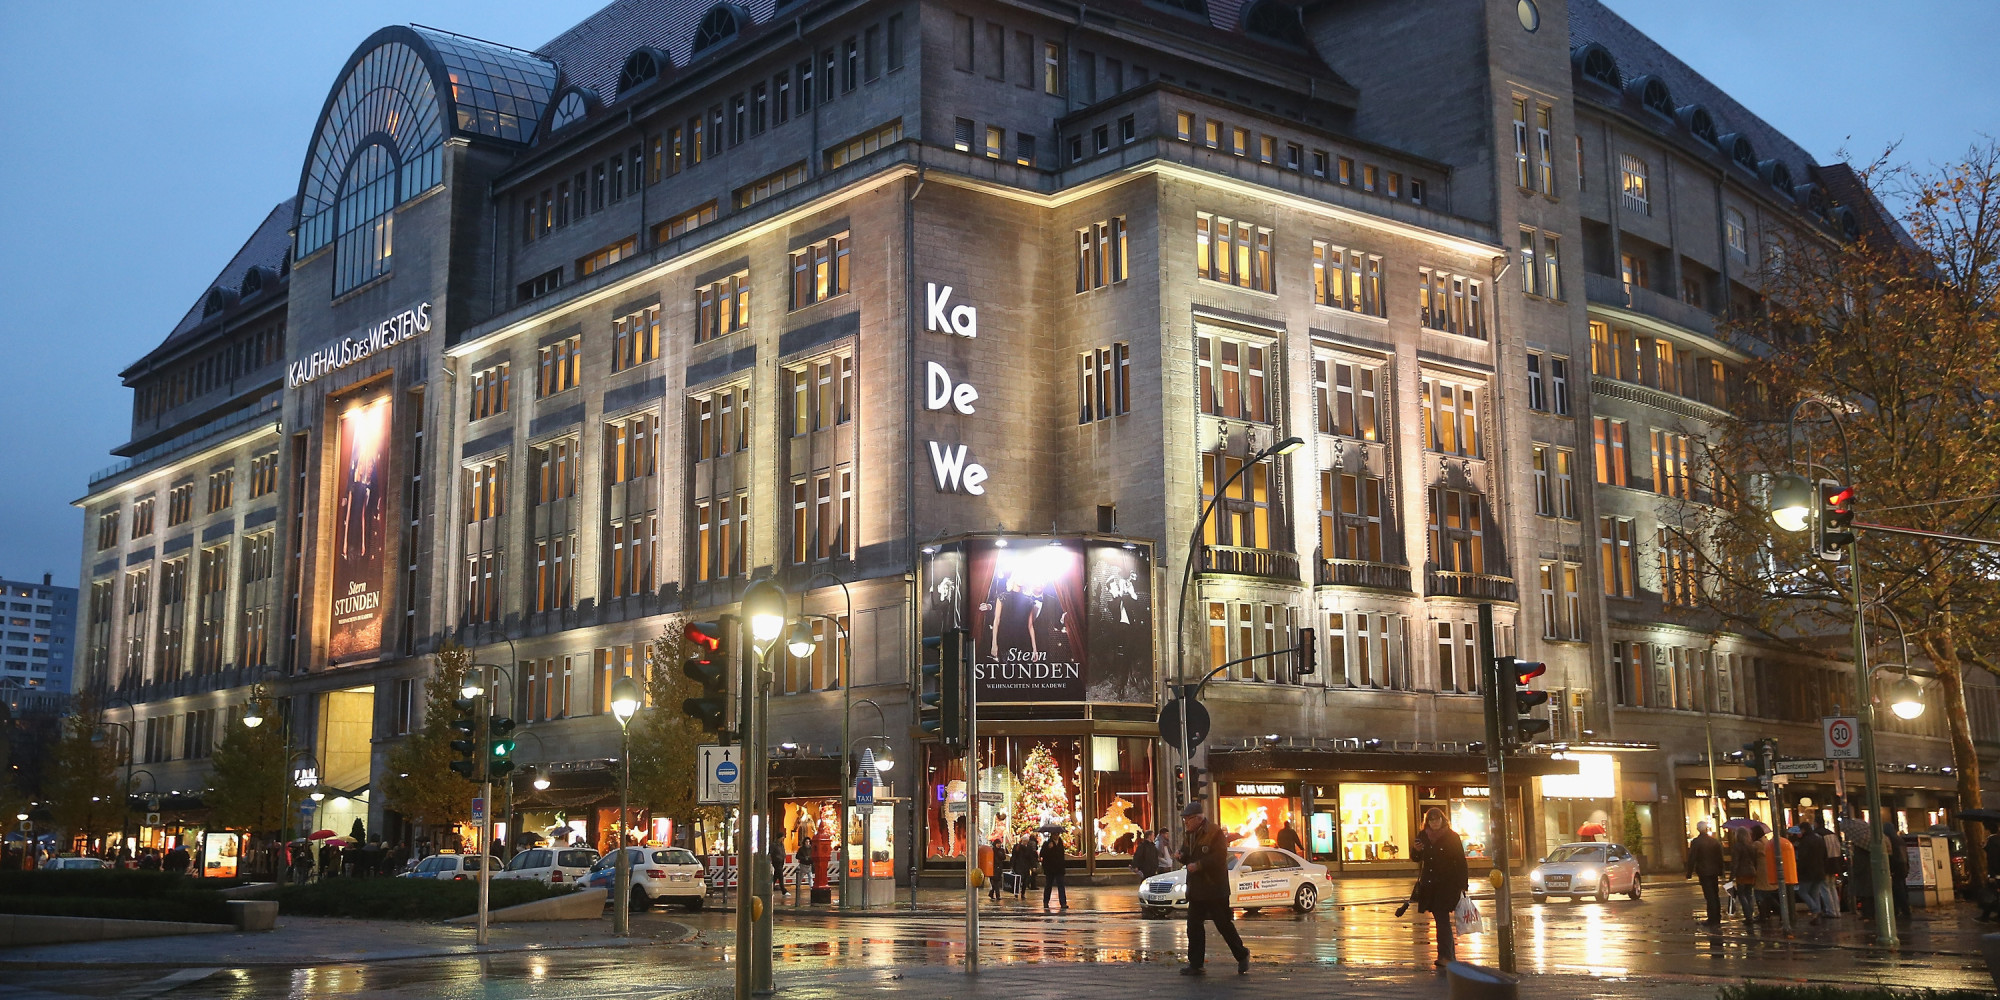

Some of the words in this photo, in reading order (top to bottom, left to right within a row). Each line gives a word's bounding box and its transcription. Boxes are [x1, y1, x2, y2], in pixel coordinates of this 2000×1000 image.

[926, 282, 977, 338] Ka
[288, 337, 352, 388] KAUFHAUS
[352, 338, 369, 360] DES
[368, 302, 432, 352] WESTENS
[926, 361, 979, 415] De
[928, 440, 988, 496] We
[348, 581, 367, 596] Stern
[334, 591, 380, 616] STUNDEN
[1007, 647, 1047, 661] Stern
[975, 662, 1080, 680] STUNDEN
[1833, 727, 1848, 740] 30
[1833, 749, 1852, 757] ZONE
[1236, 784, 1256, 794] LOUIS
[1256, 784, 1285, 794] VUITTON
